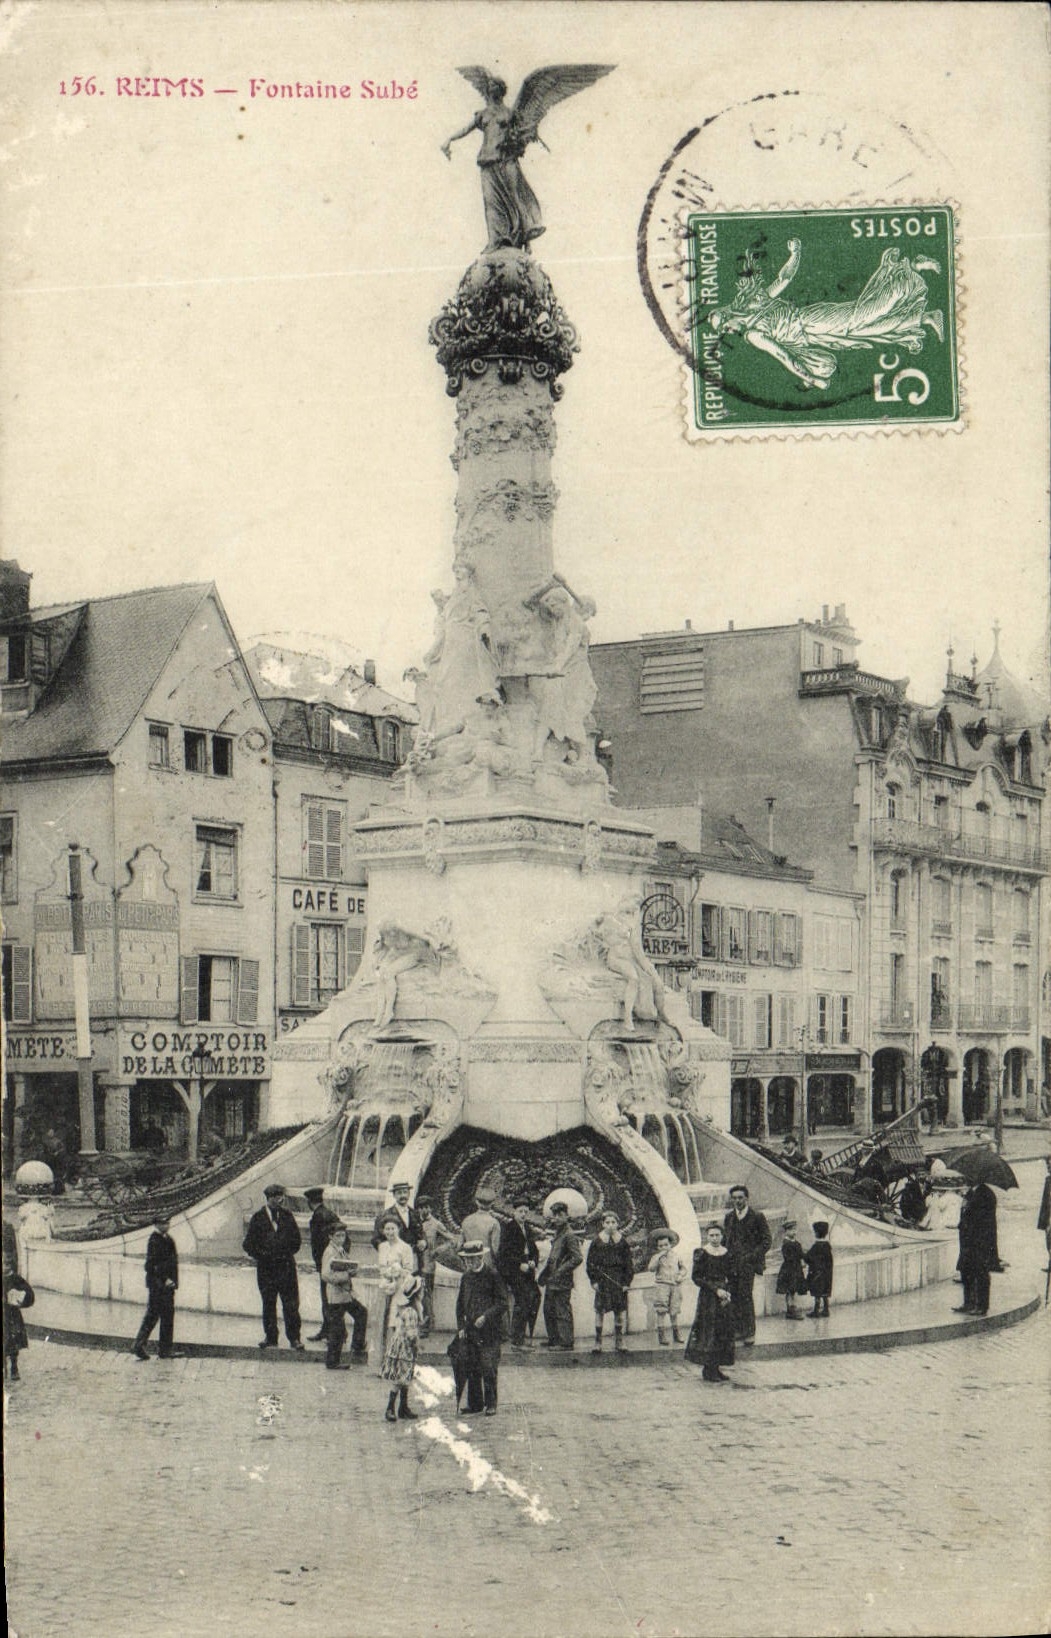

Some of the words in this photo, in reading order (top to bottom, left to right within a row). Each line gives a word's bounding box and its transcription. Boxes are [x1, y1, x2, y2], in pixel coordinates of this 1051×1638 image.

[851, 217, 938, 239] POSTES
[699, 223, 720, 306] FRANÇAISE
[292, 887, 339, 913] CAFÉ
[347, 897, 365, 914] DE
[130, 1031, 268, 1053] COMPTOIR
[122, 1056, 147, 1075] DE
[150, 1056, 177, 1075] LA
